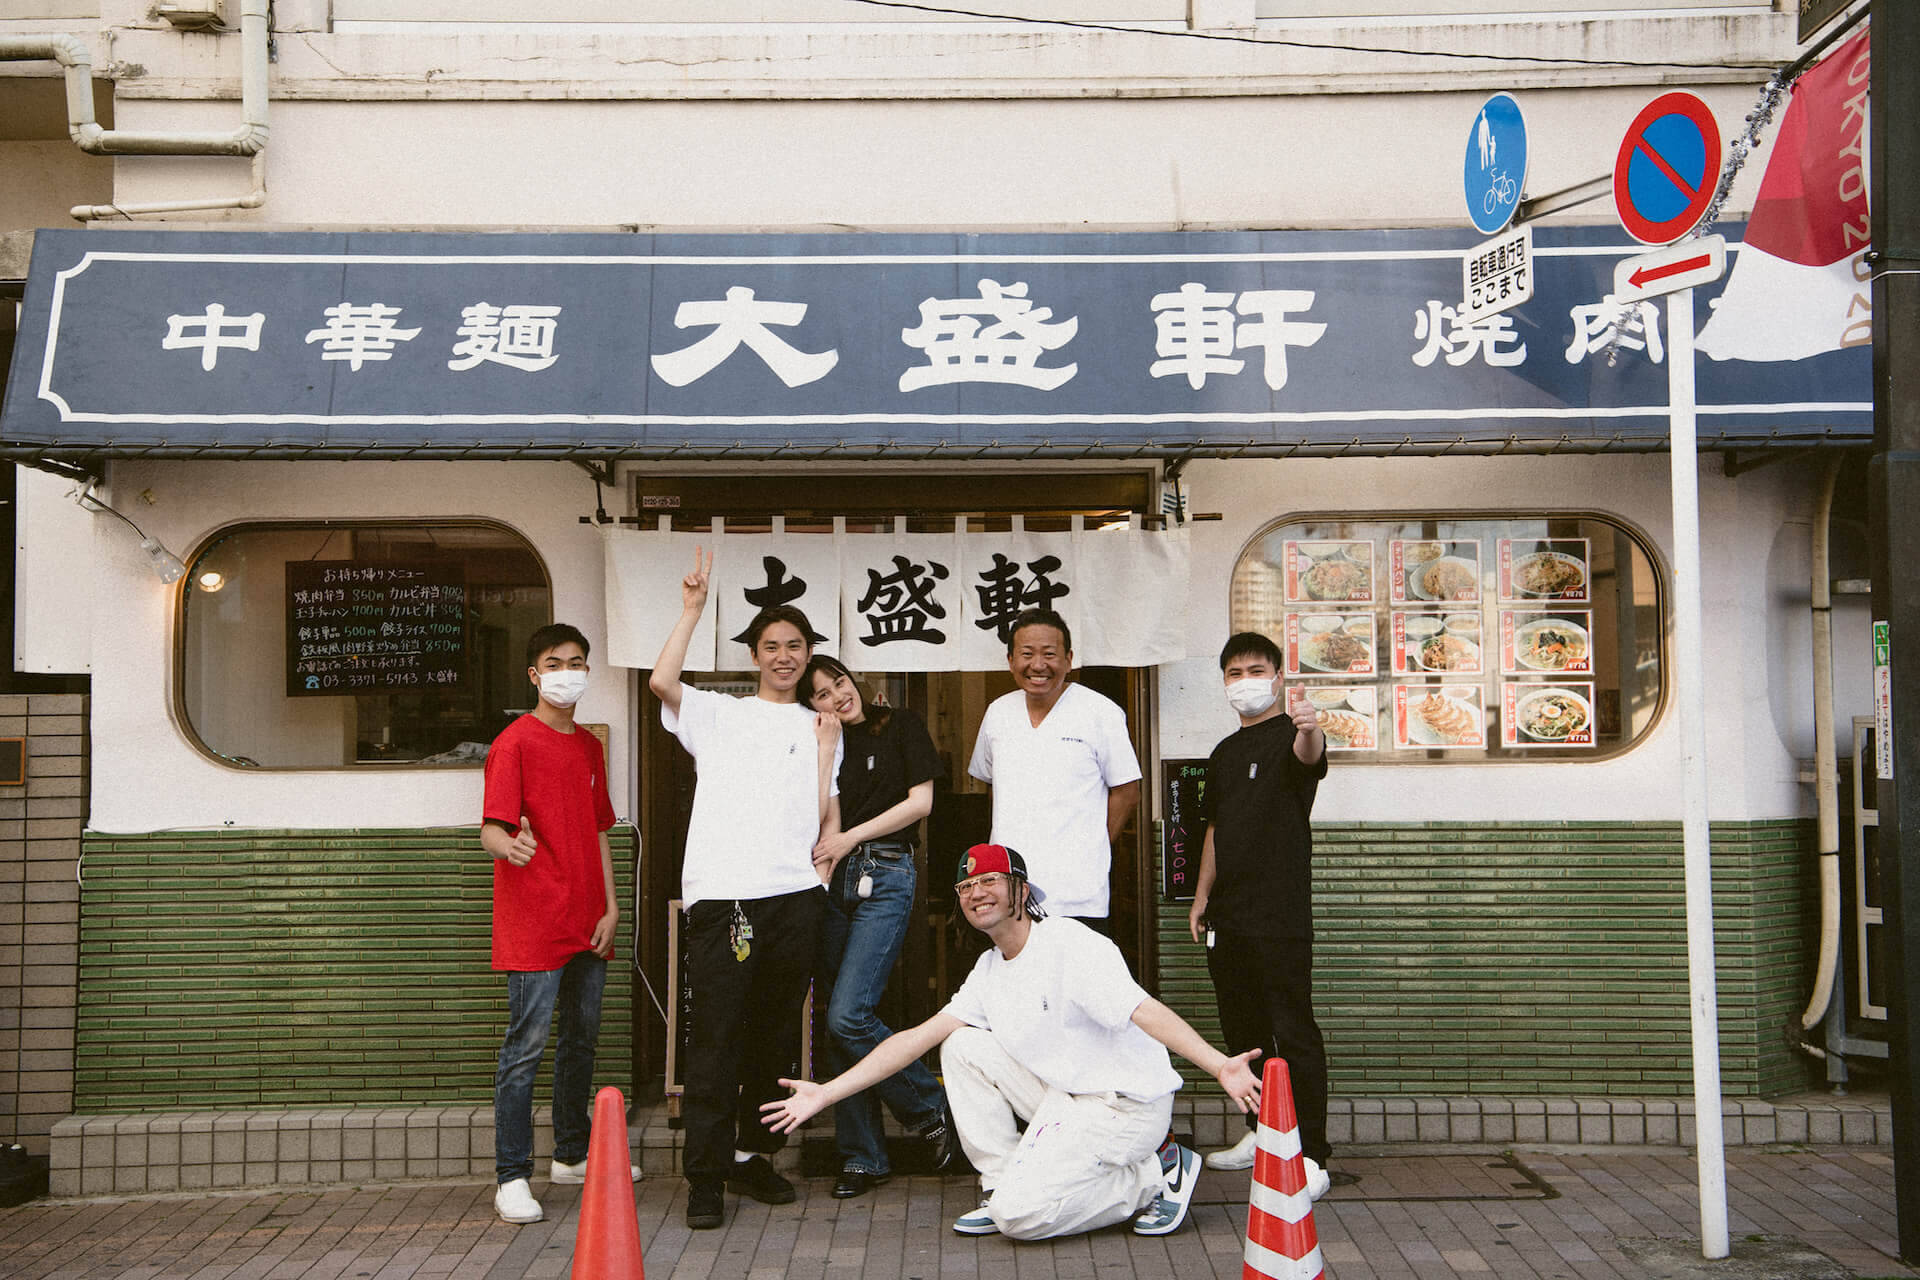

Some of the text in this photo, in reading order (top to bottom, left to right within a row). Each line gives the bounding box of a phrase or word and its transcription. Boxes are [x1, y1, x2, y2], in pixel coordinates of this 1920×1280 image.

[1839, 25, 1871, 202] OKYO
[1470, 235, 1527, 283] 自転車通行可
[1471, 268, 1527, 311] ここまで
[162, 278, 1666, 392] 中華麺 大盛軒 焼肉
[324, 568, 425, 583] お持ち帰りメニュー
[294, 588, 345, 604] 焼肉弁当
[389, 585, 440, 599] カルビ弁当
[295, 605, 349, 619] 玉子チャーハン
[352, 605, 384, 617] 700円
[298, 622, 461, 641] 餃子単品 500円 餃子ライス 700円
[425, 640, 461, 652] 850円
